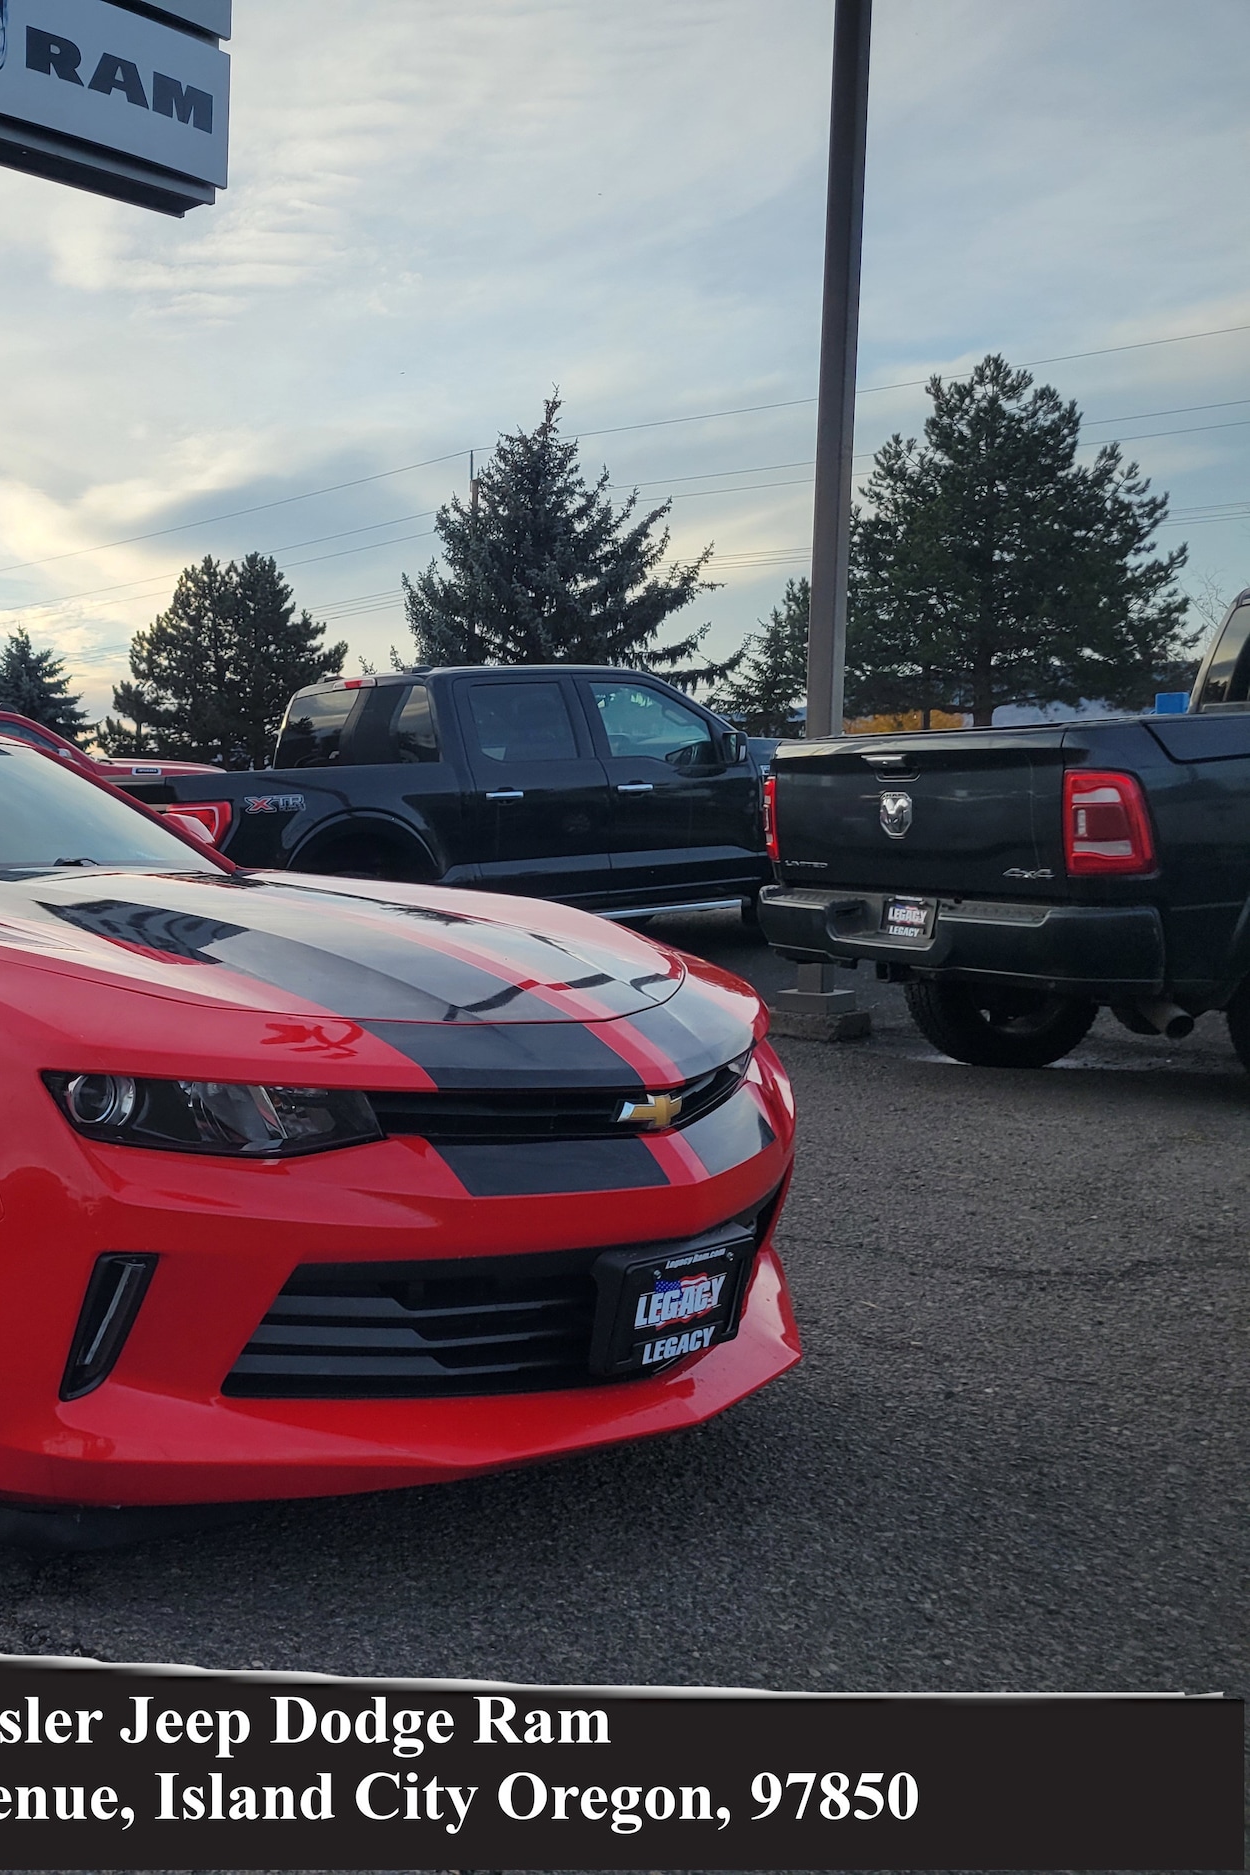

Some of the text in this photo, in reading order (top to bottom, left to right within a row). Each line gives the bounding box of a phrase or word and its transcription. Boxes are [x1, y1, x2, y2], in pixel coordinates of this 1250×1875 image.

[25, 25, 213, 134] RAM
[888, 907, 927, 923] LEGACY
[888, 925, 920, 938] LEGACY
[634, 1275, 727, 1327] LEGACY
[642, 1327, 715, 1365] LEGACY
